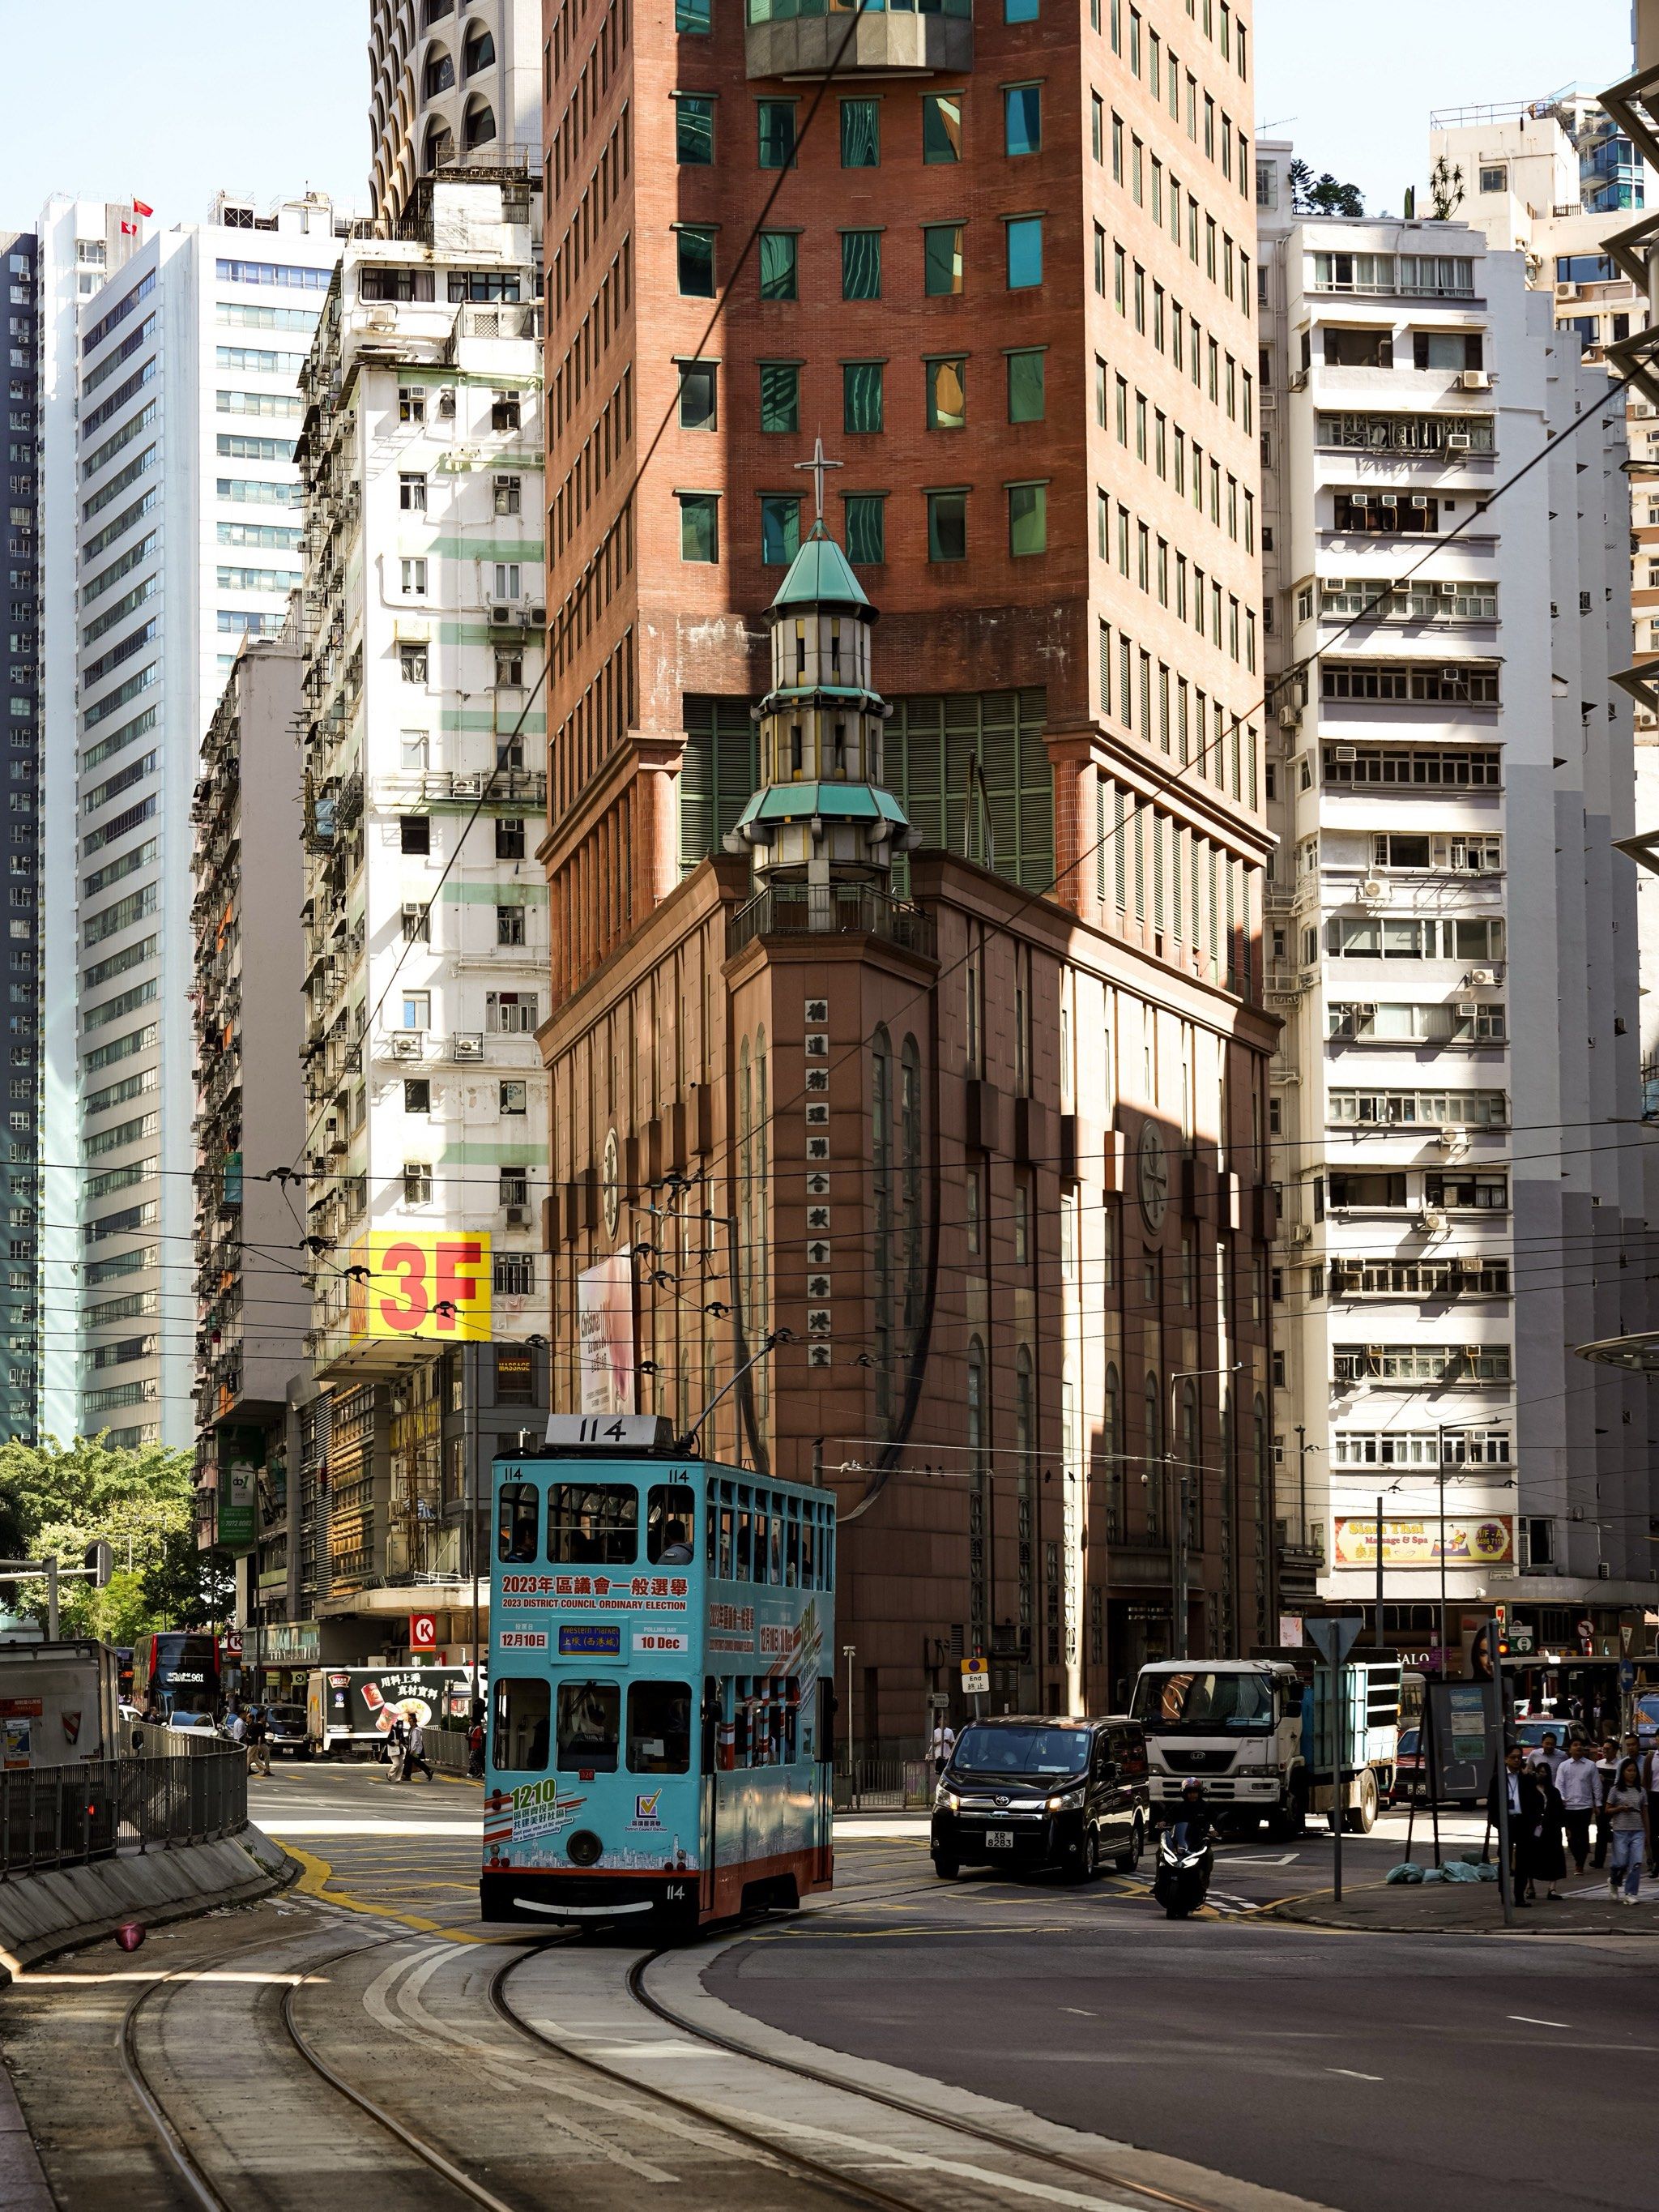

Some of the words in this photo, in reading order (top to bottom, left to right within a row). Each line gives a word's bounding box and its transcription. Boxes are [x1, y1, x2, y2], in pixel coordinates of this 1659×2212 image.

[380, 1241, 481, 1331] 3F
[499, 1362, 530, 1371] MASSAGE
[579, 1418, 626, 1441] 114
[505, 1467, 523, 1480] 114
[669, 1469, 689, 1484] 114
[1391, 1522, 1424, 1535] Thai
[1365, 1536, 1401, 1545] Masage
[1412, 1536, 1428, 1544] Spa
[501, 1576, 688, 1597] 2023年區議會一般選舉
[502, 1599, 521, 1608] 2023
[523, 1599, 558, 1608] DISTRICT
[561, 1600, 596, 1608] COUNCIL
[599, 1600, 642, 1610] ORDINARY
[646, 1601, 686, 1610] ELECTION
[502, 1634, 545, 1646] 12月10日
[642, 1637, 654, 1649] 10
[657, 1637, 680, 1649] Dec
[191, 1673, 203, 1682] 961
[967, 1683, 984, 1691] 終止
[511, 1779, 556, 1811] 1210
[667, 1885, 685, 1900] 114
